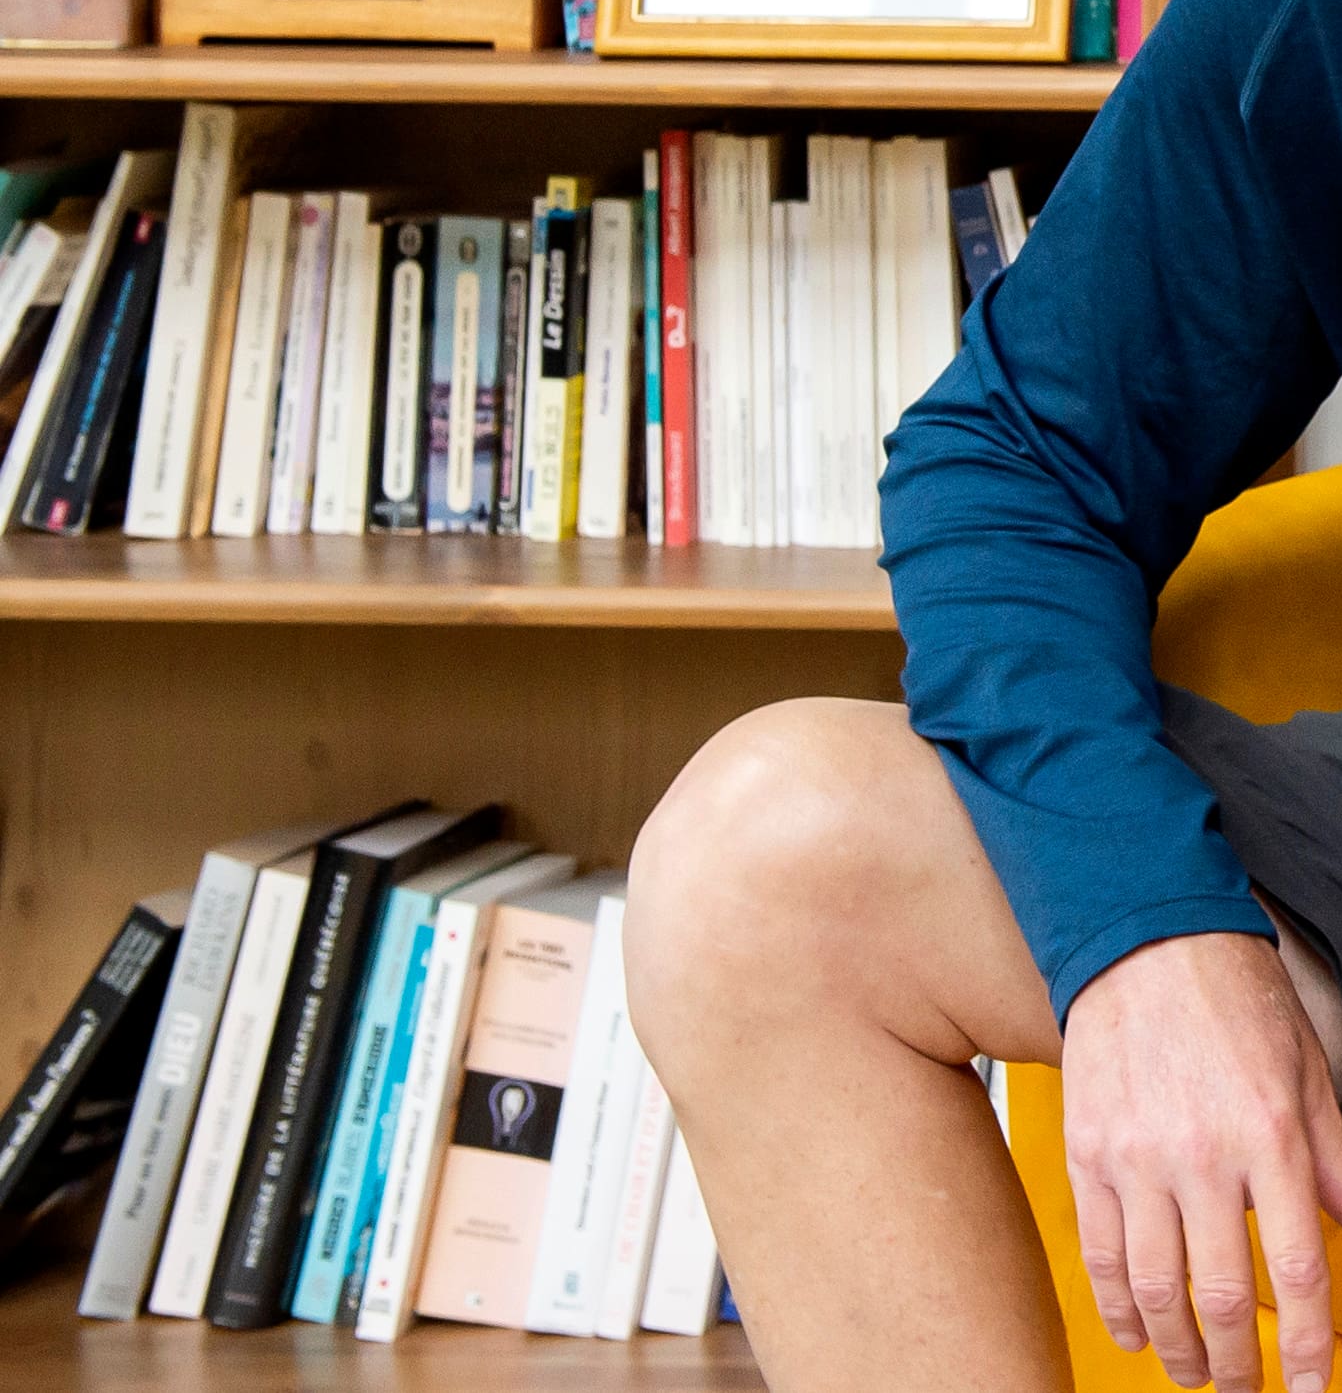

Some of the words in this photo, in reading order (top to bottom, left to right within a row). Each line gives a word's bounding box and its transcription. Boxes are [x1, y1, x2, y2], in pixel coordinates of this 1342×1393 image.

[544, 248, 566, 320] Dessin
[542, 324, 562, 351] Le
[159, 1010, 199, 1087] DIEU
[278, 994, 323, 1115] LITTÉRATURE
[264, 1149, 286, 1177] DE
[271, 1117, 294, 1144] LA
[241, 1178, 279, 1269] HISTOIRE
